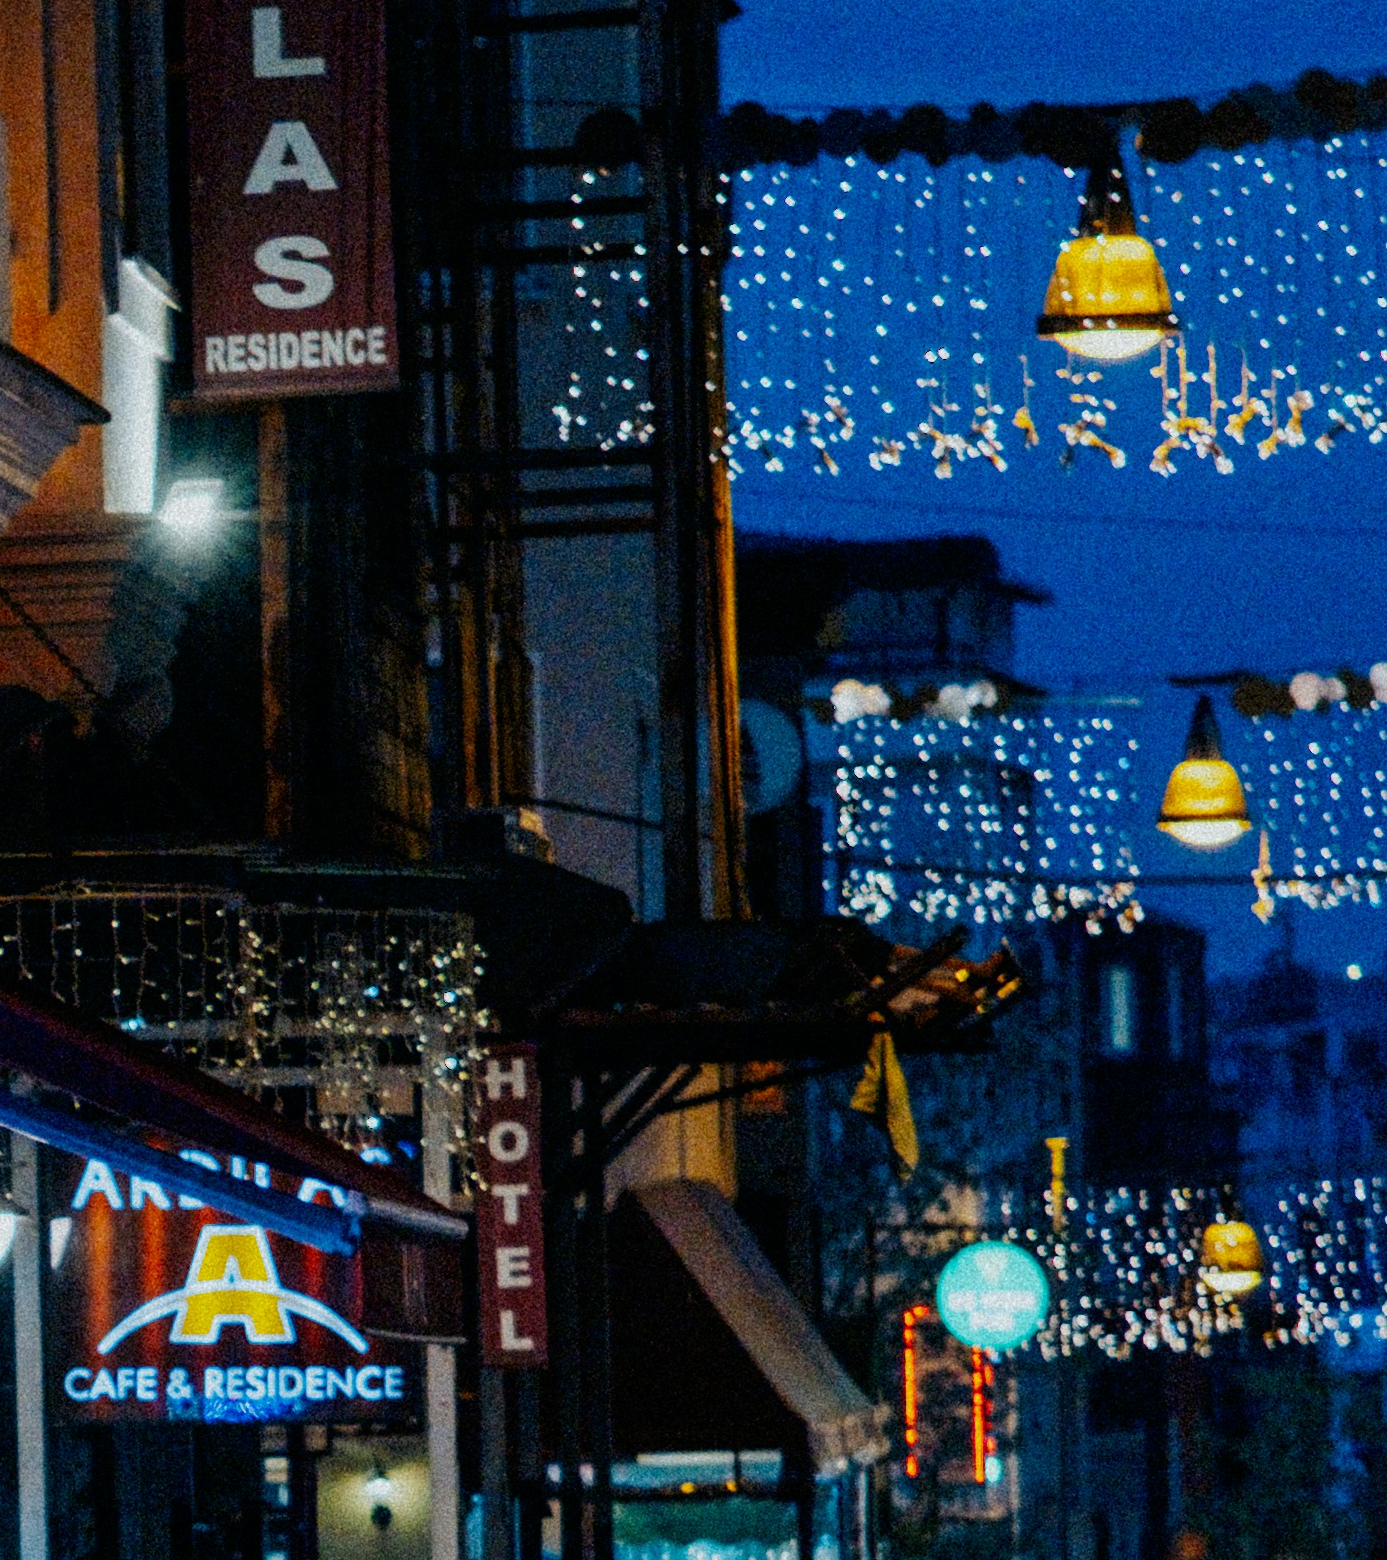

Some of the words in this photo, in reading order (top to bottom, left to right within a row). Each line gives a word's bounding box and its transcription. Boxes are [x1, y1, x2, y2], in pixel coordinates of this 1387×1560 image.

[204, 327, 388, 375] RESIDENCE
[484, 1056, 534, 1351] HOTEL
[63, 1365, 159, 1402] CAFE
[166, 1365, 195, 1402] &
[203, 1364, 405, 1401] RESIDENCE
